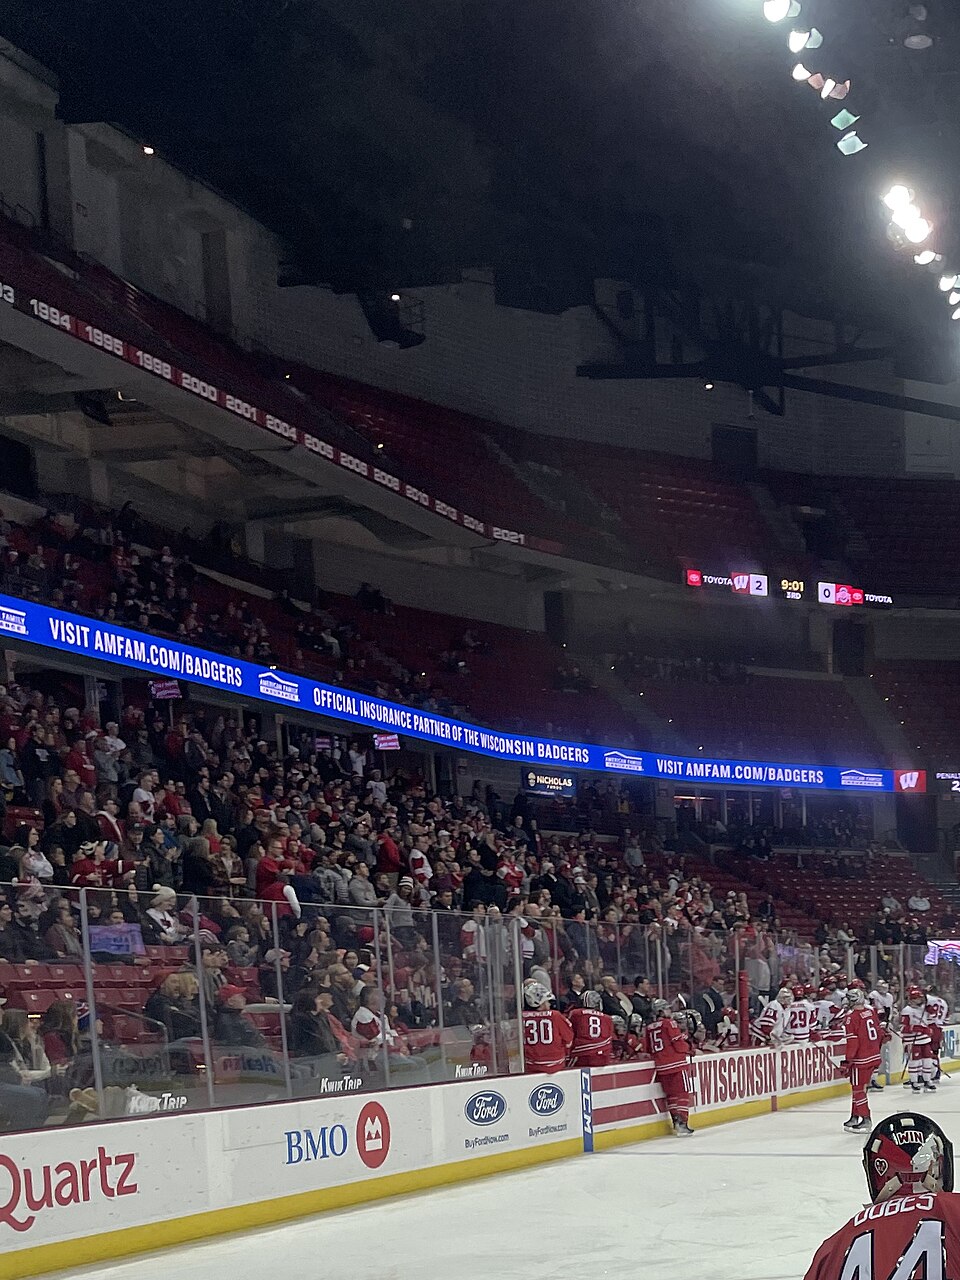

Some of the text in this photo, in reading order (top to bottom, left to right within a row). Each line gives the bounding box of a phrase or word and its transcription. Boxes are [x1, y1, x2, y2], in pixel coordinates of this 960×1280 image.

[30, 299, 71, 330] 1994
[85, 325, 124, 356] 1995
[136, 350, 172, 379] 1998
[181, 373, 217, 401] 2000
[226, 395, 257, 421] 2001
[266, 414, 296, 441] 2004
[493, 526, 525, 545] 2021
[703, 575, 733, 586] TOYOTA
[756, 581, 763, 591] 2
[781, 579, 804, 592] 9:01
[786, 591, 801, 600] 3RD
[823, 588, 893, 604] 0 TOYOTA
[49, 617, 243, 687] VISIT AMFAM.COM/BADGERS
[313, 687, 590, 763] OFFICIAL INSURANCE PARTNER OF THE WISCONSIN BADGERS
[536, 775, 573, 788] NICHOLAS
[656, 758, 824, 784] VISIT AMFAM.COM/BADGERS
[589, 1016, 601, 1038] 8
[790, 1010, 807, 1029] 29
[866, 1019, 877, 1040] 6
[525, 1019, 553, 1045] 30
[701, 1053, 777, 1105] WISCONSIN
[781, 1044, 834, 1090] BADGERS
[473, 1096, 499, 1120] Ford
[536, 1088, 557, 1110] Ford
[581, 1071, 592, 1134] CCM
[464, 1133, 509, 1149] BuyFordNow.com
[528, 1123, 567, 1138] BuyFordNow.com
[284, 1124, 348, 1165] BMO
